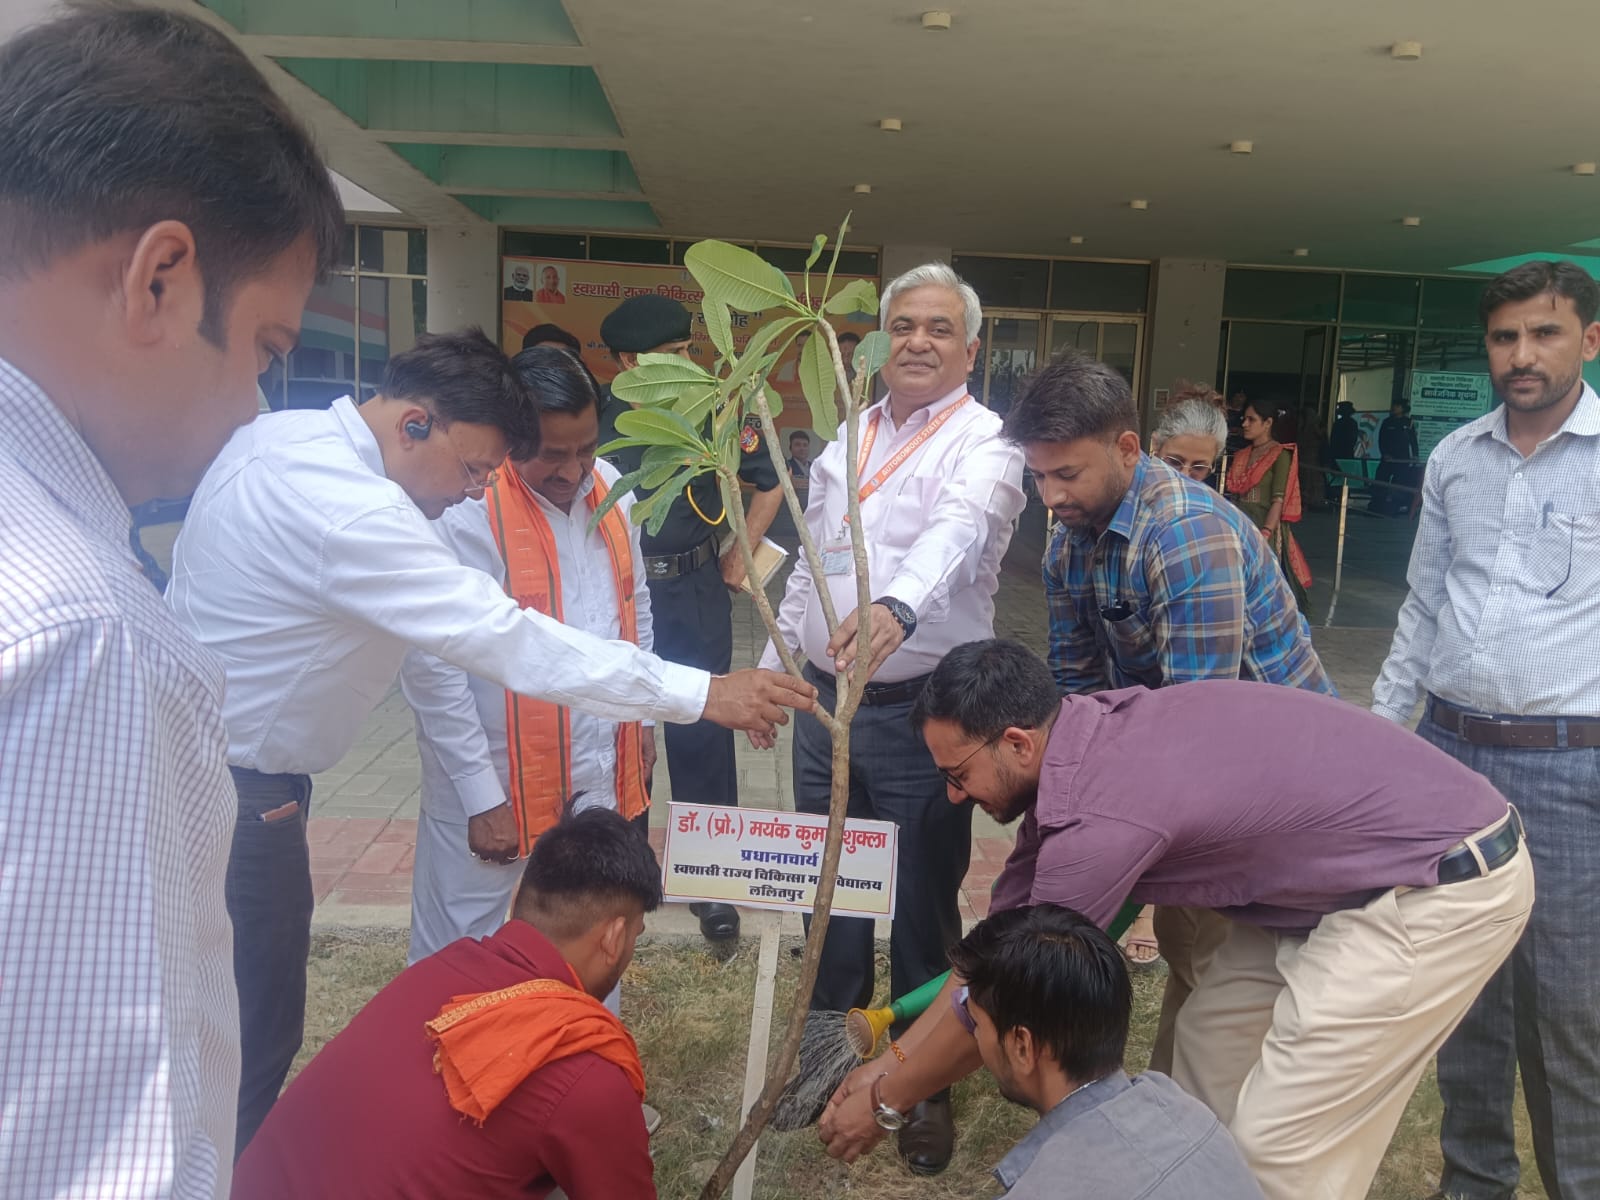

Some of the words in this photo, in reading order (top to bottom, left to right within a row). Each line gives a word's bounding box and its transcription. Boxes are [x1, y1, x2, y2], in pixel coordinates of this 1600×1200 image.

[573, 282, 620, 297] स्वशासी
[657, 285, 704, 302] चिकित्स
[882, 437, 923, 477] AUTONOMOUS
[922, 418, 940, 438] STATE
[677, 811, 700, 833] डॉ.
[707, 811, 744, 842] (प्रो.)
[749, 817, 792, 839] मयंक
[843, 829, 888, 854] शुक्ला
[740, 849, 820, 867] प्रधानाचार्य
[673, 863, 720, 877] स्वशासी
[722, 867, 752, 879] राज्य
[754, 867, 806, 884] चिकित्सा
[749, 884, 805, 902] ललितपुर
